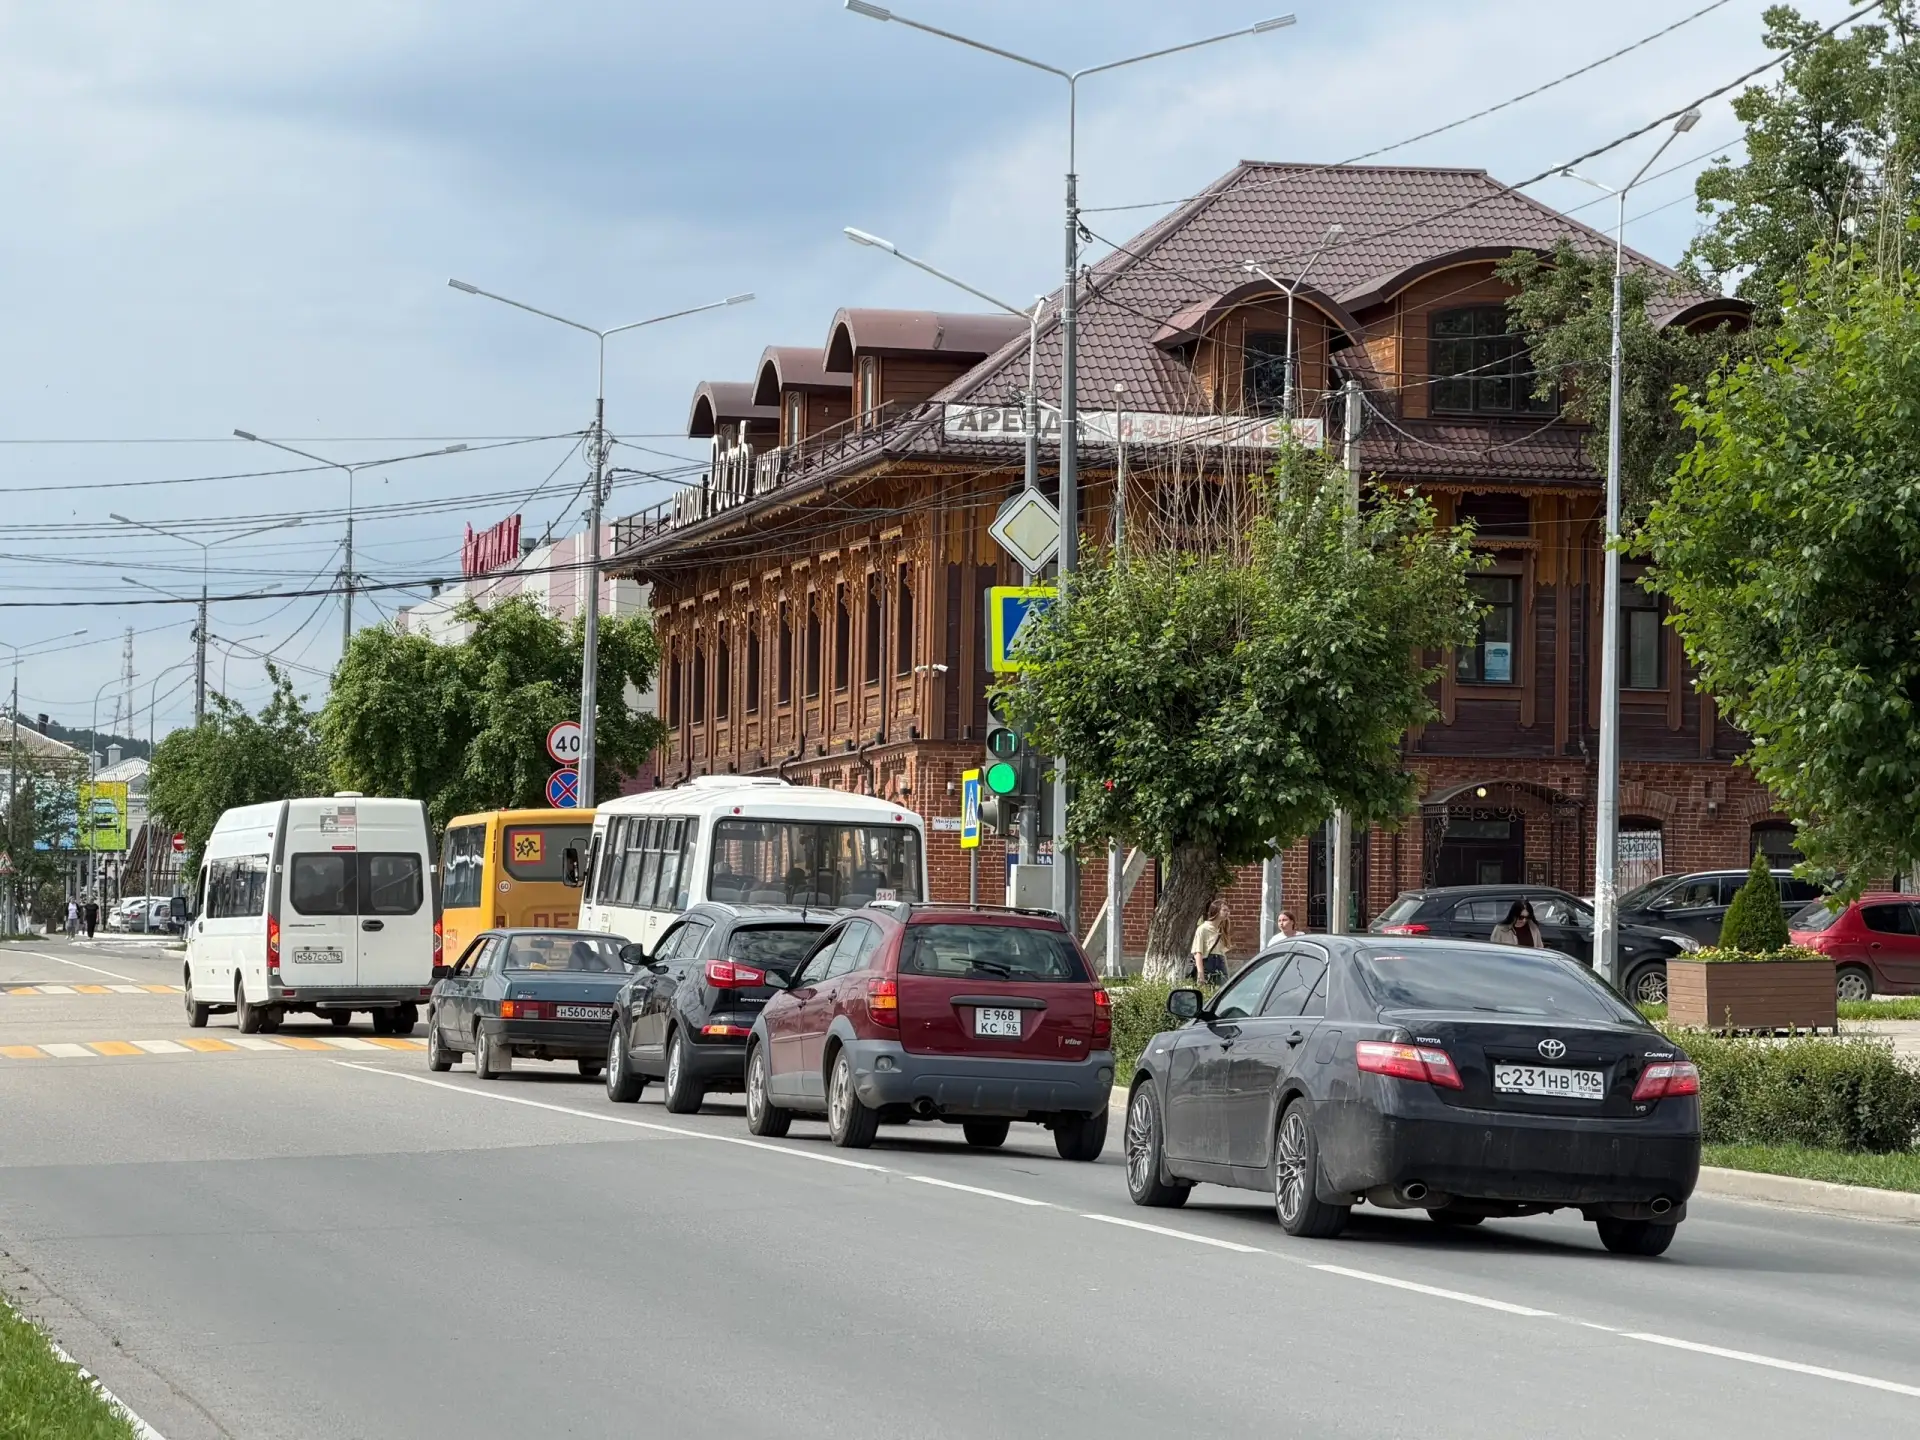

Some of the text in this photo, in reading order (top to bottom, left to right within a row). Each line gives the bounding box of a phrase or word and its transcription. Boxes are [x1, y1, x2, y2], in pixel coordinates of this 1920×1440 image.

[556, 735, 580, 752] 40
[996, 733, 1015, 752] 17
[560, 1007, 611, 1018] Н560ОК 66
[981, 1023, 1017, 1033] КС 96
[1415, 1036, 1442, 1045] TOYOTA
[1500, 1068, 1600, 1090] С231НВ 196
